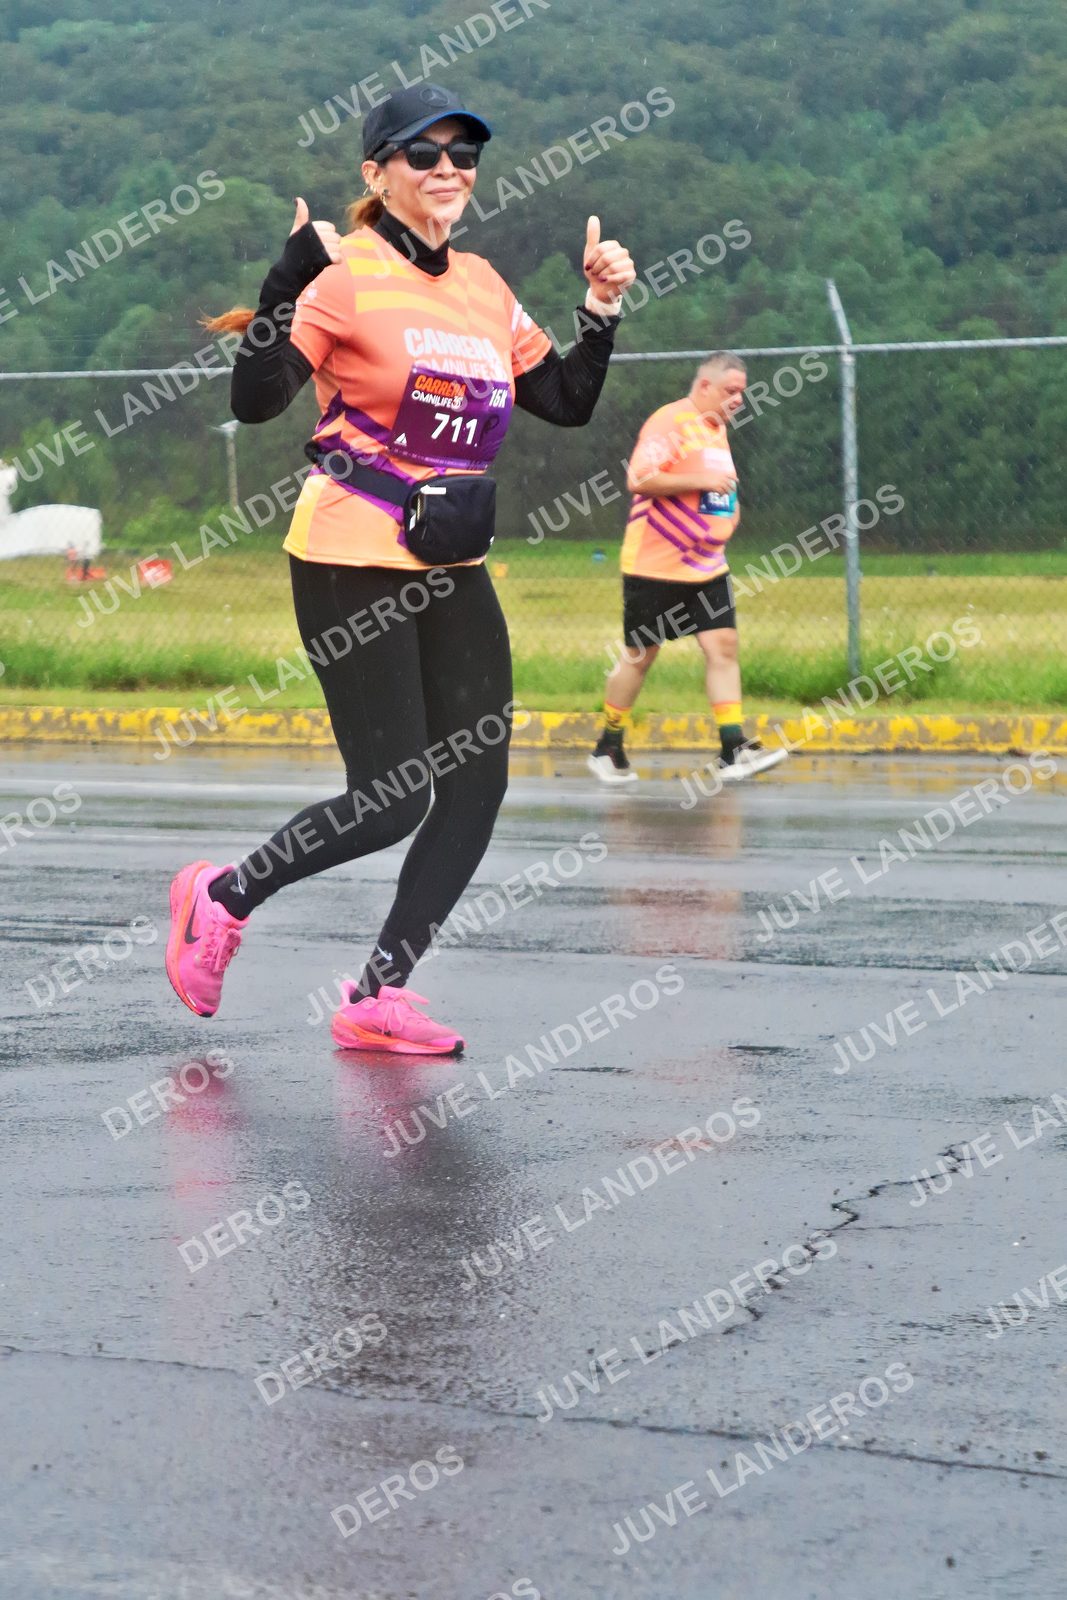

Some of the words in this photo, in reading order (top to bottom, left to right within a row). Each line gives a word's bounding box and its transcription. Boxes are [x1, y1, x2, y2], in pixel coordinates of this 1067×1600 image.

[404, 328, 500, 362] CARRERA
[415, 375, 467, 397] CARRERA
[431, 412, 478, 445] 711
